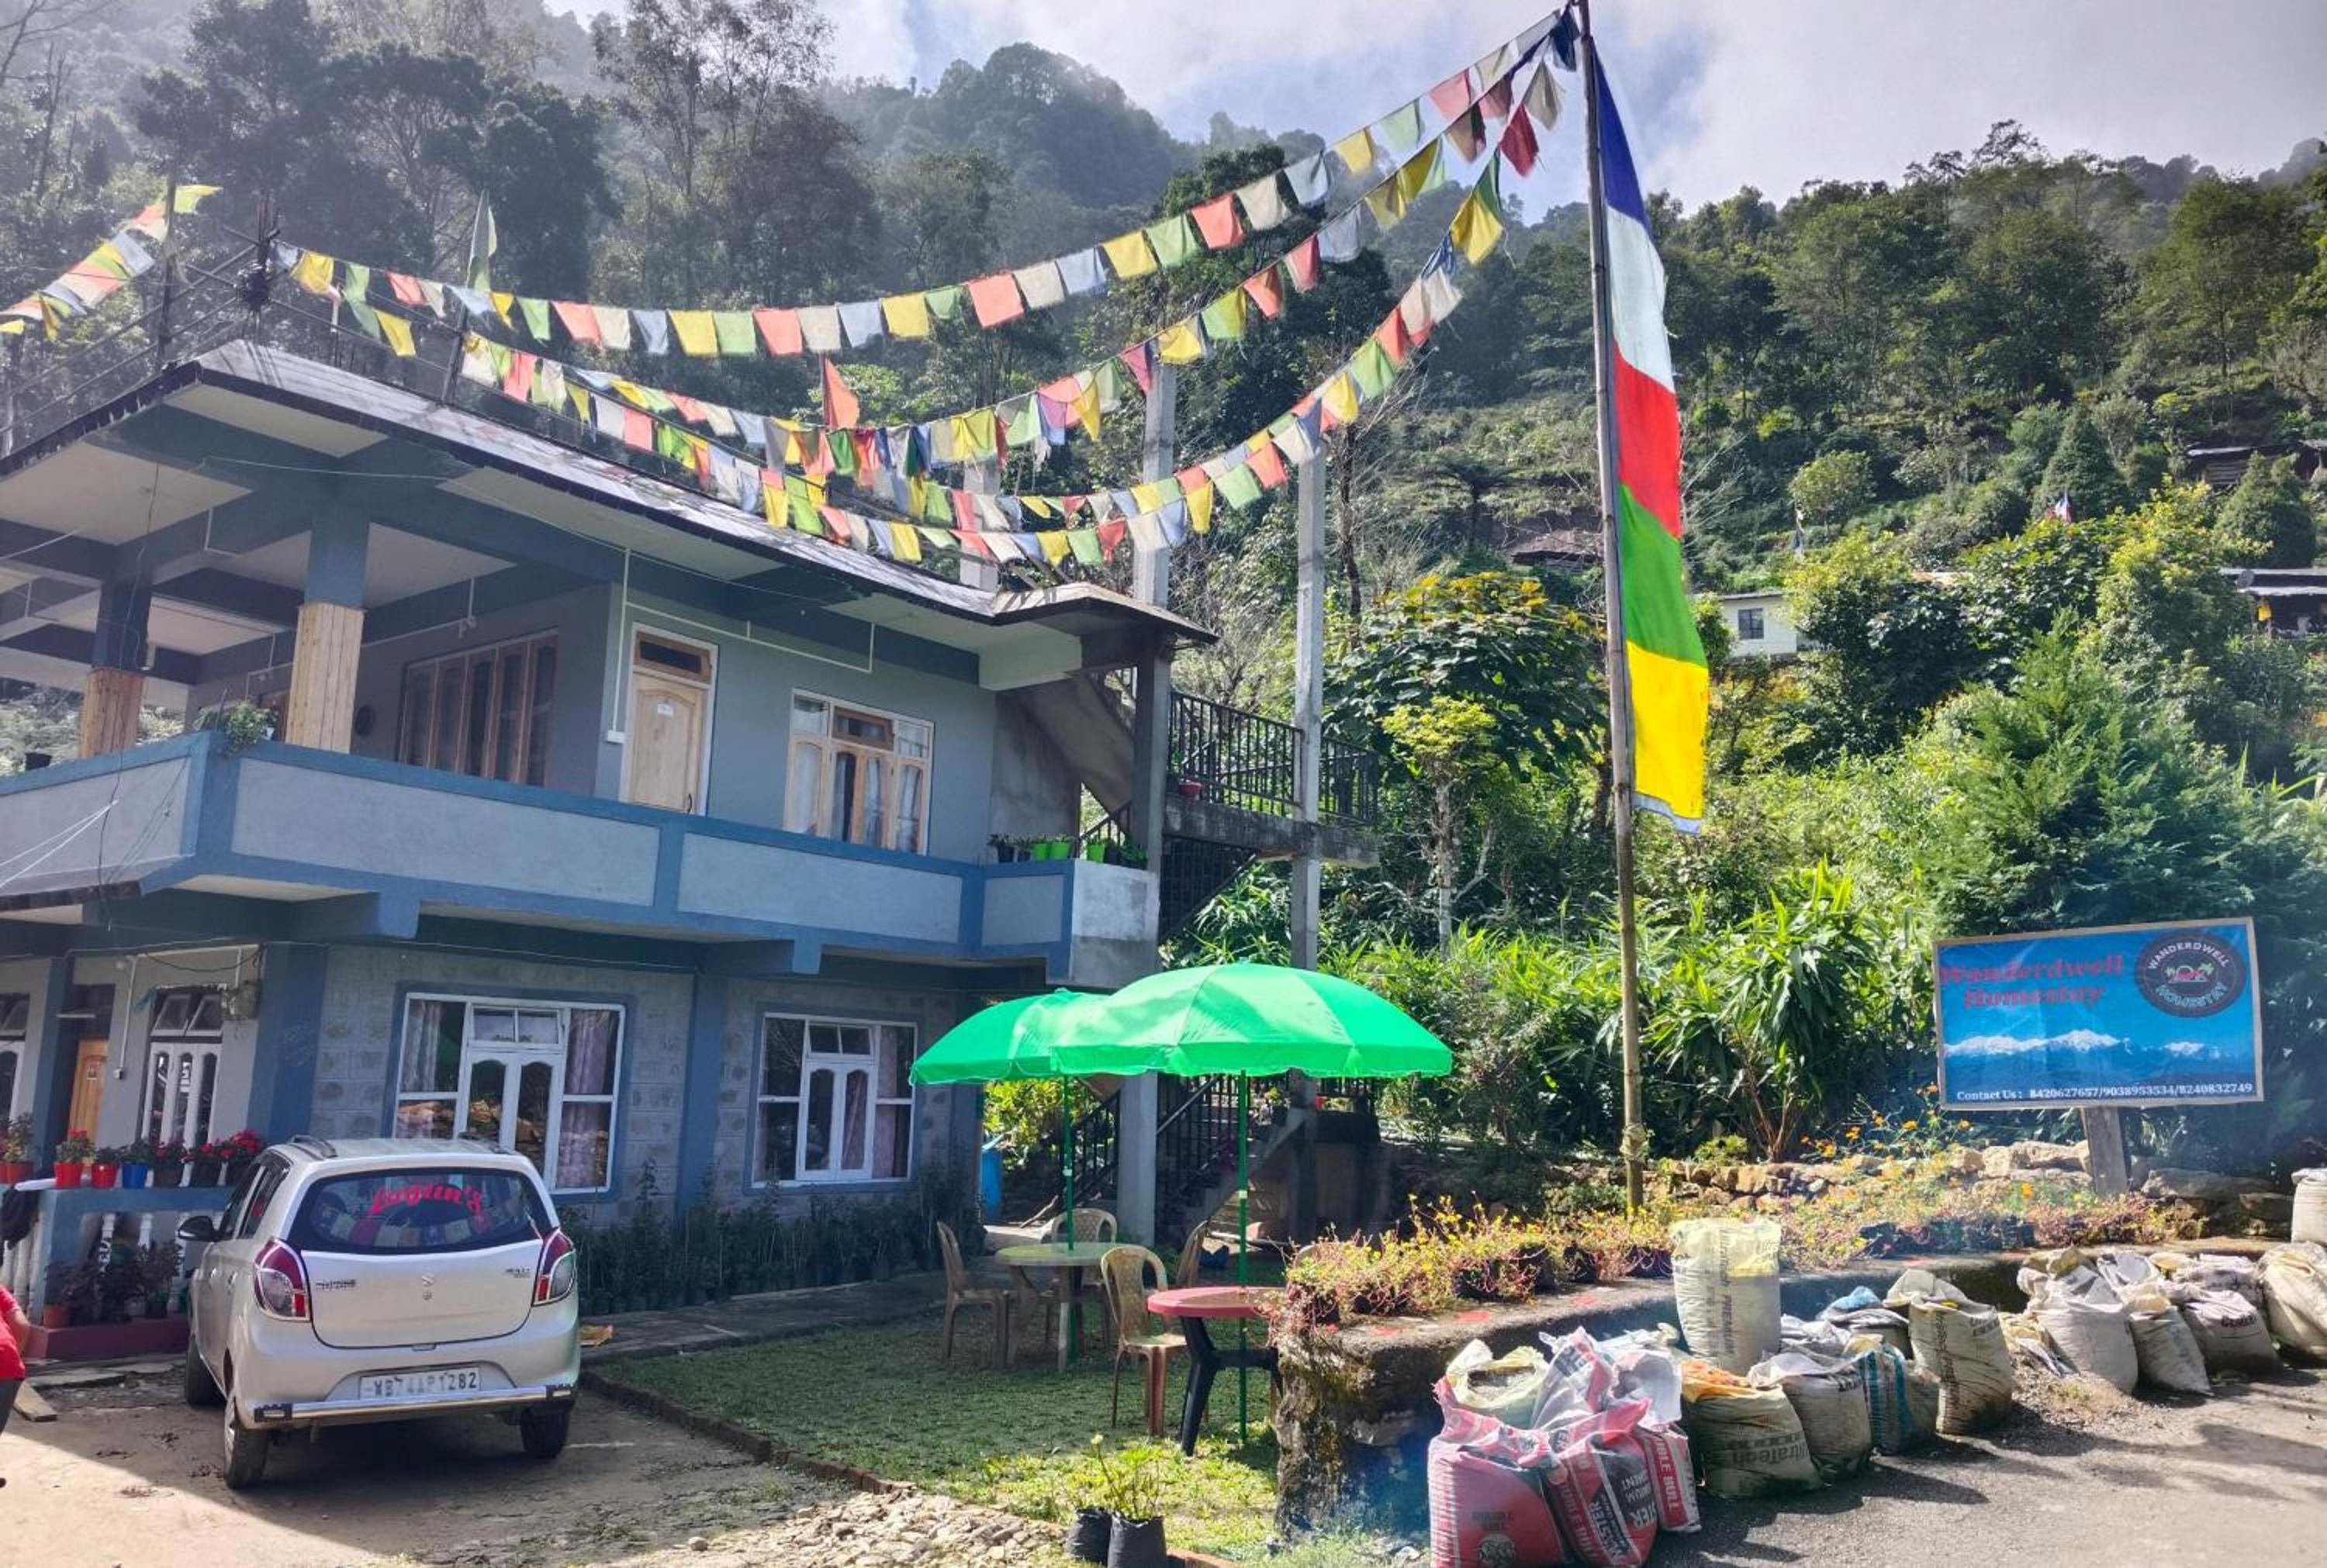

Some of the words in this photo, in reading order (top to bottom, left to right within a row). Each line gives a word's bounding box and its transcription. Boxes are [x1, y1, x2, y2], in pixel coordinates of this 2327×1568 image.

[2148, 941, 2230, 969] WANDERDWELL
[1957, 1090, 2000, 1100] Contact
[1662, 1476, 1679, 1512] BULL
